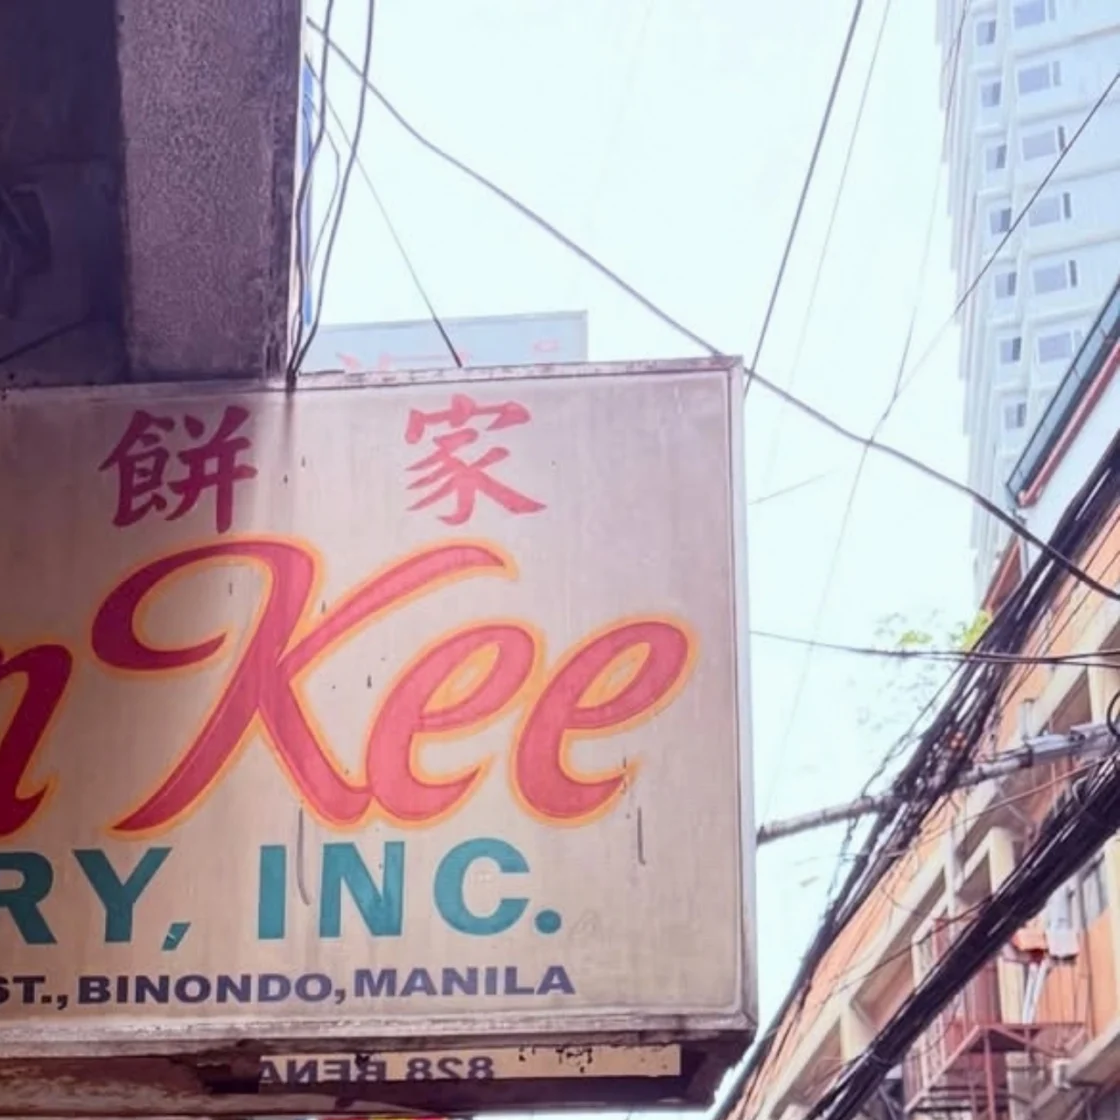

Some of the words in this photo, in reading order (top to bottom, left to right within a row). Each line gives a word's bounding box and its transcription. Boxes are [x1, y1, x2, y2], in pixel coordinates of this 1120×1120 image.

[90, 540, 689, 834] Kee
[257, 837, 562, 939] INC.
[353, 966, 576, 998] MANILA
